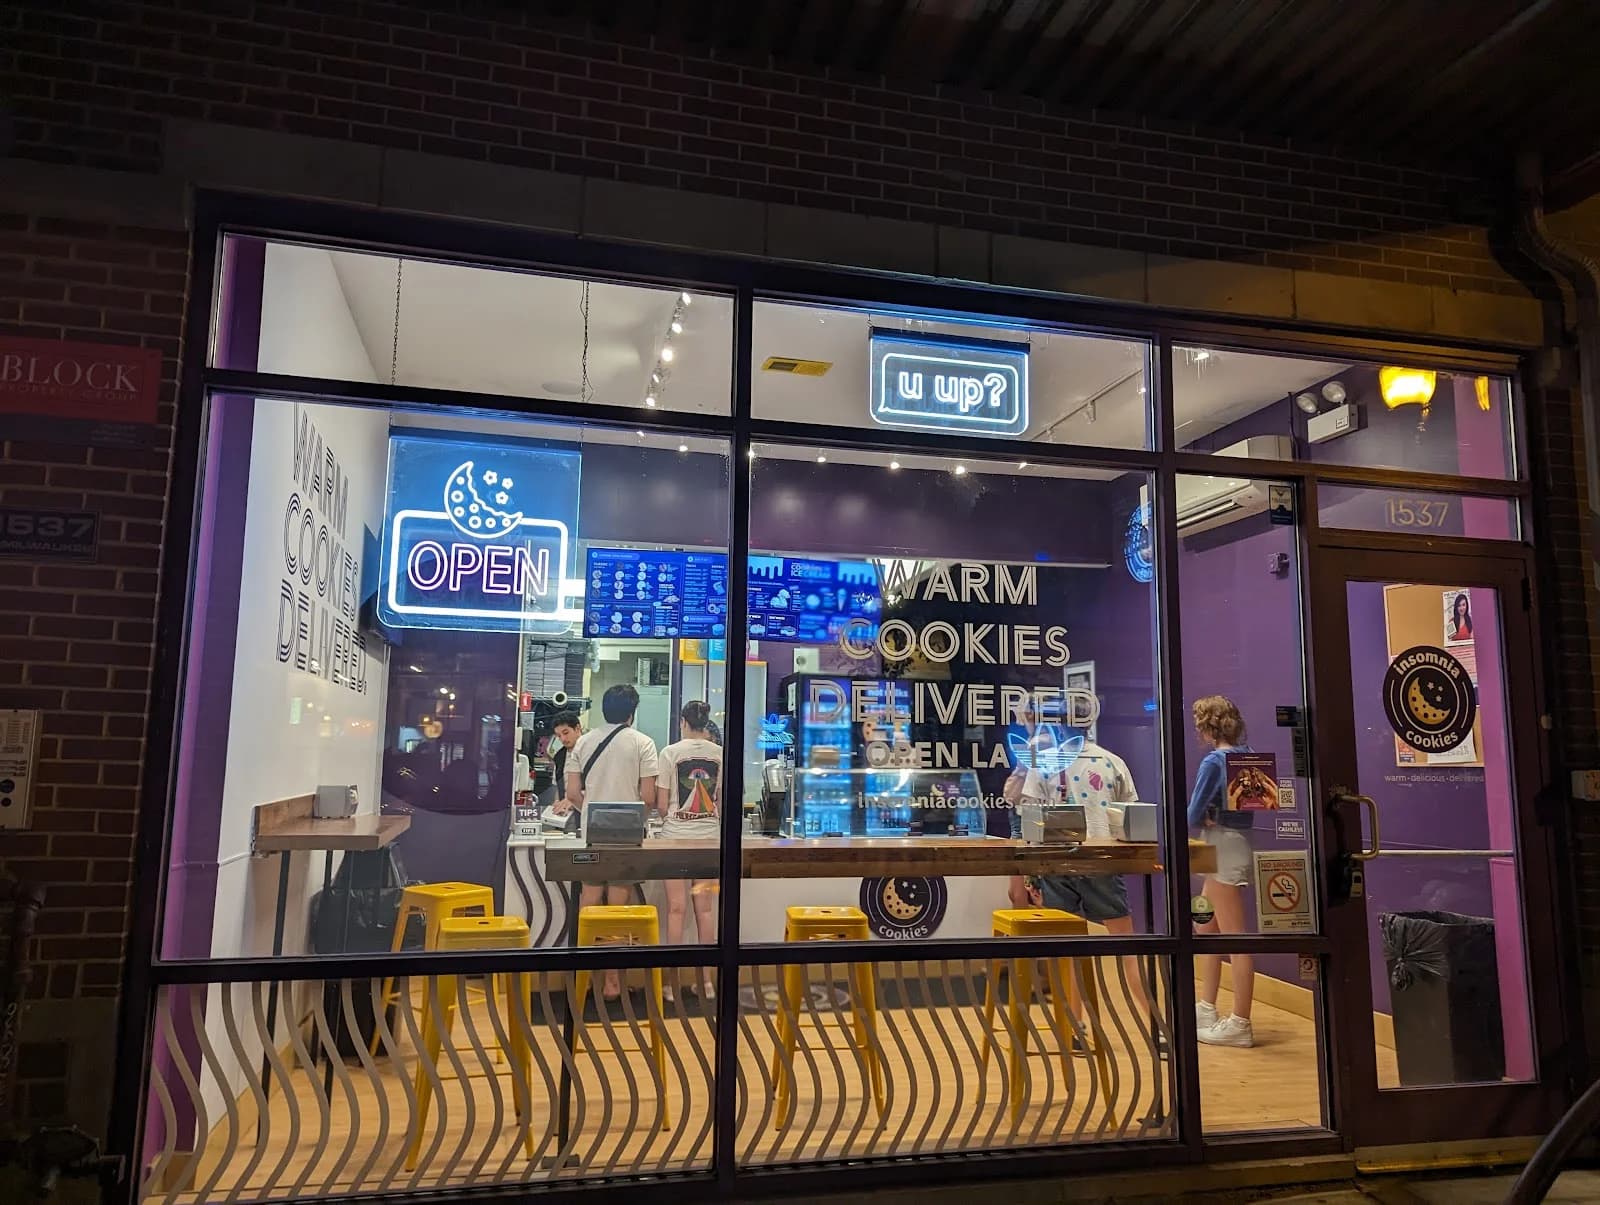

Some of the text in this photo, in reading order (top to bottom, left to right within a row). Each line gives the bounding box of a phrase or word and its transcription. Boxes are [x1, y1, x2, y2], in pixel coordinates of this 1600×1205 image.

[0, 354, 138, 392] BLOCK
[898, 371, 1007, 413] u up?
[293, 400, 350, 541] WARM
[1385, 495, 1449, 527] 1537
[284, 491, 359, 623] COOKIES
[406, 539, 550, 596] OPEN
[873, 557, 1039, 607] WARM
[838, 618, 1072, 667] COOKIES
[1393, 651, 1462, 681] insomnia
[808, 679, 1102, 728] DELIVERED
[865, 741, 961, 769] OPEN
[1405, 728, 1460, 750] cookies
[518, 808, 538, 817] TIPS
[878, 924, 929, 940] cookies
